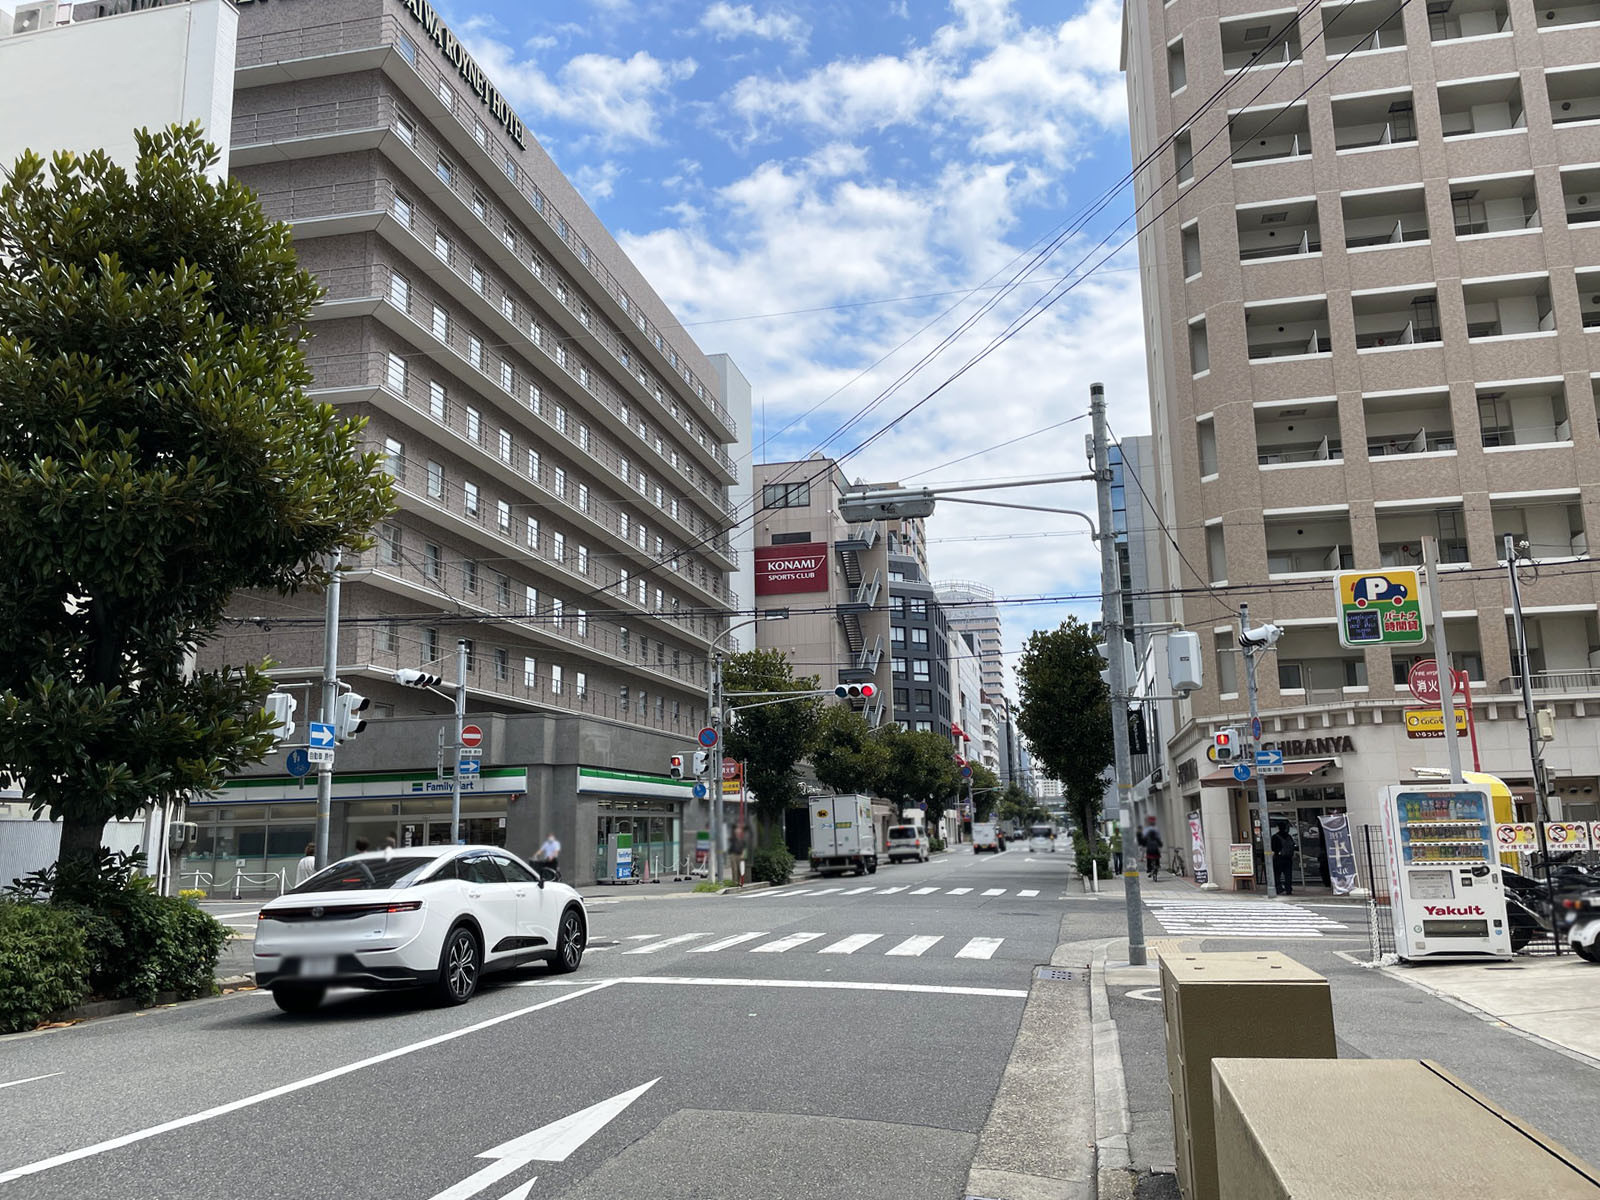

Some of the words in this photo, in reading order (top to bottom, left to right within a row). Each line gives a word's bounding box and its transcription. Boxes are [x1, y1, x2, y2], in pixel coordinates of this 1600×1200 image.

[402, 0, 443, 47] AIWA
[446, 29, 491, 104] ROYNET
[492, 92, 526, 150] HOTEL
[768, 559, 815, 571] KONAMI
[1366, 578, 1388, 600] P
[1417, 680, 1438, 692] 消火
[1260, 735, 1357, 757] CHIBANYA
[426, 781, 474, 791] Familyart
[1424, 905, 1485, 916] Yakult
